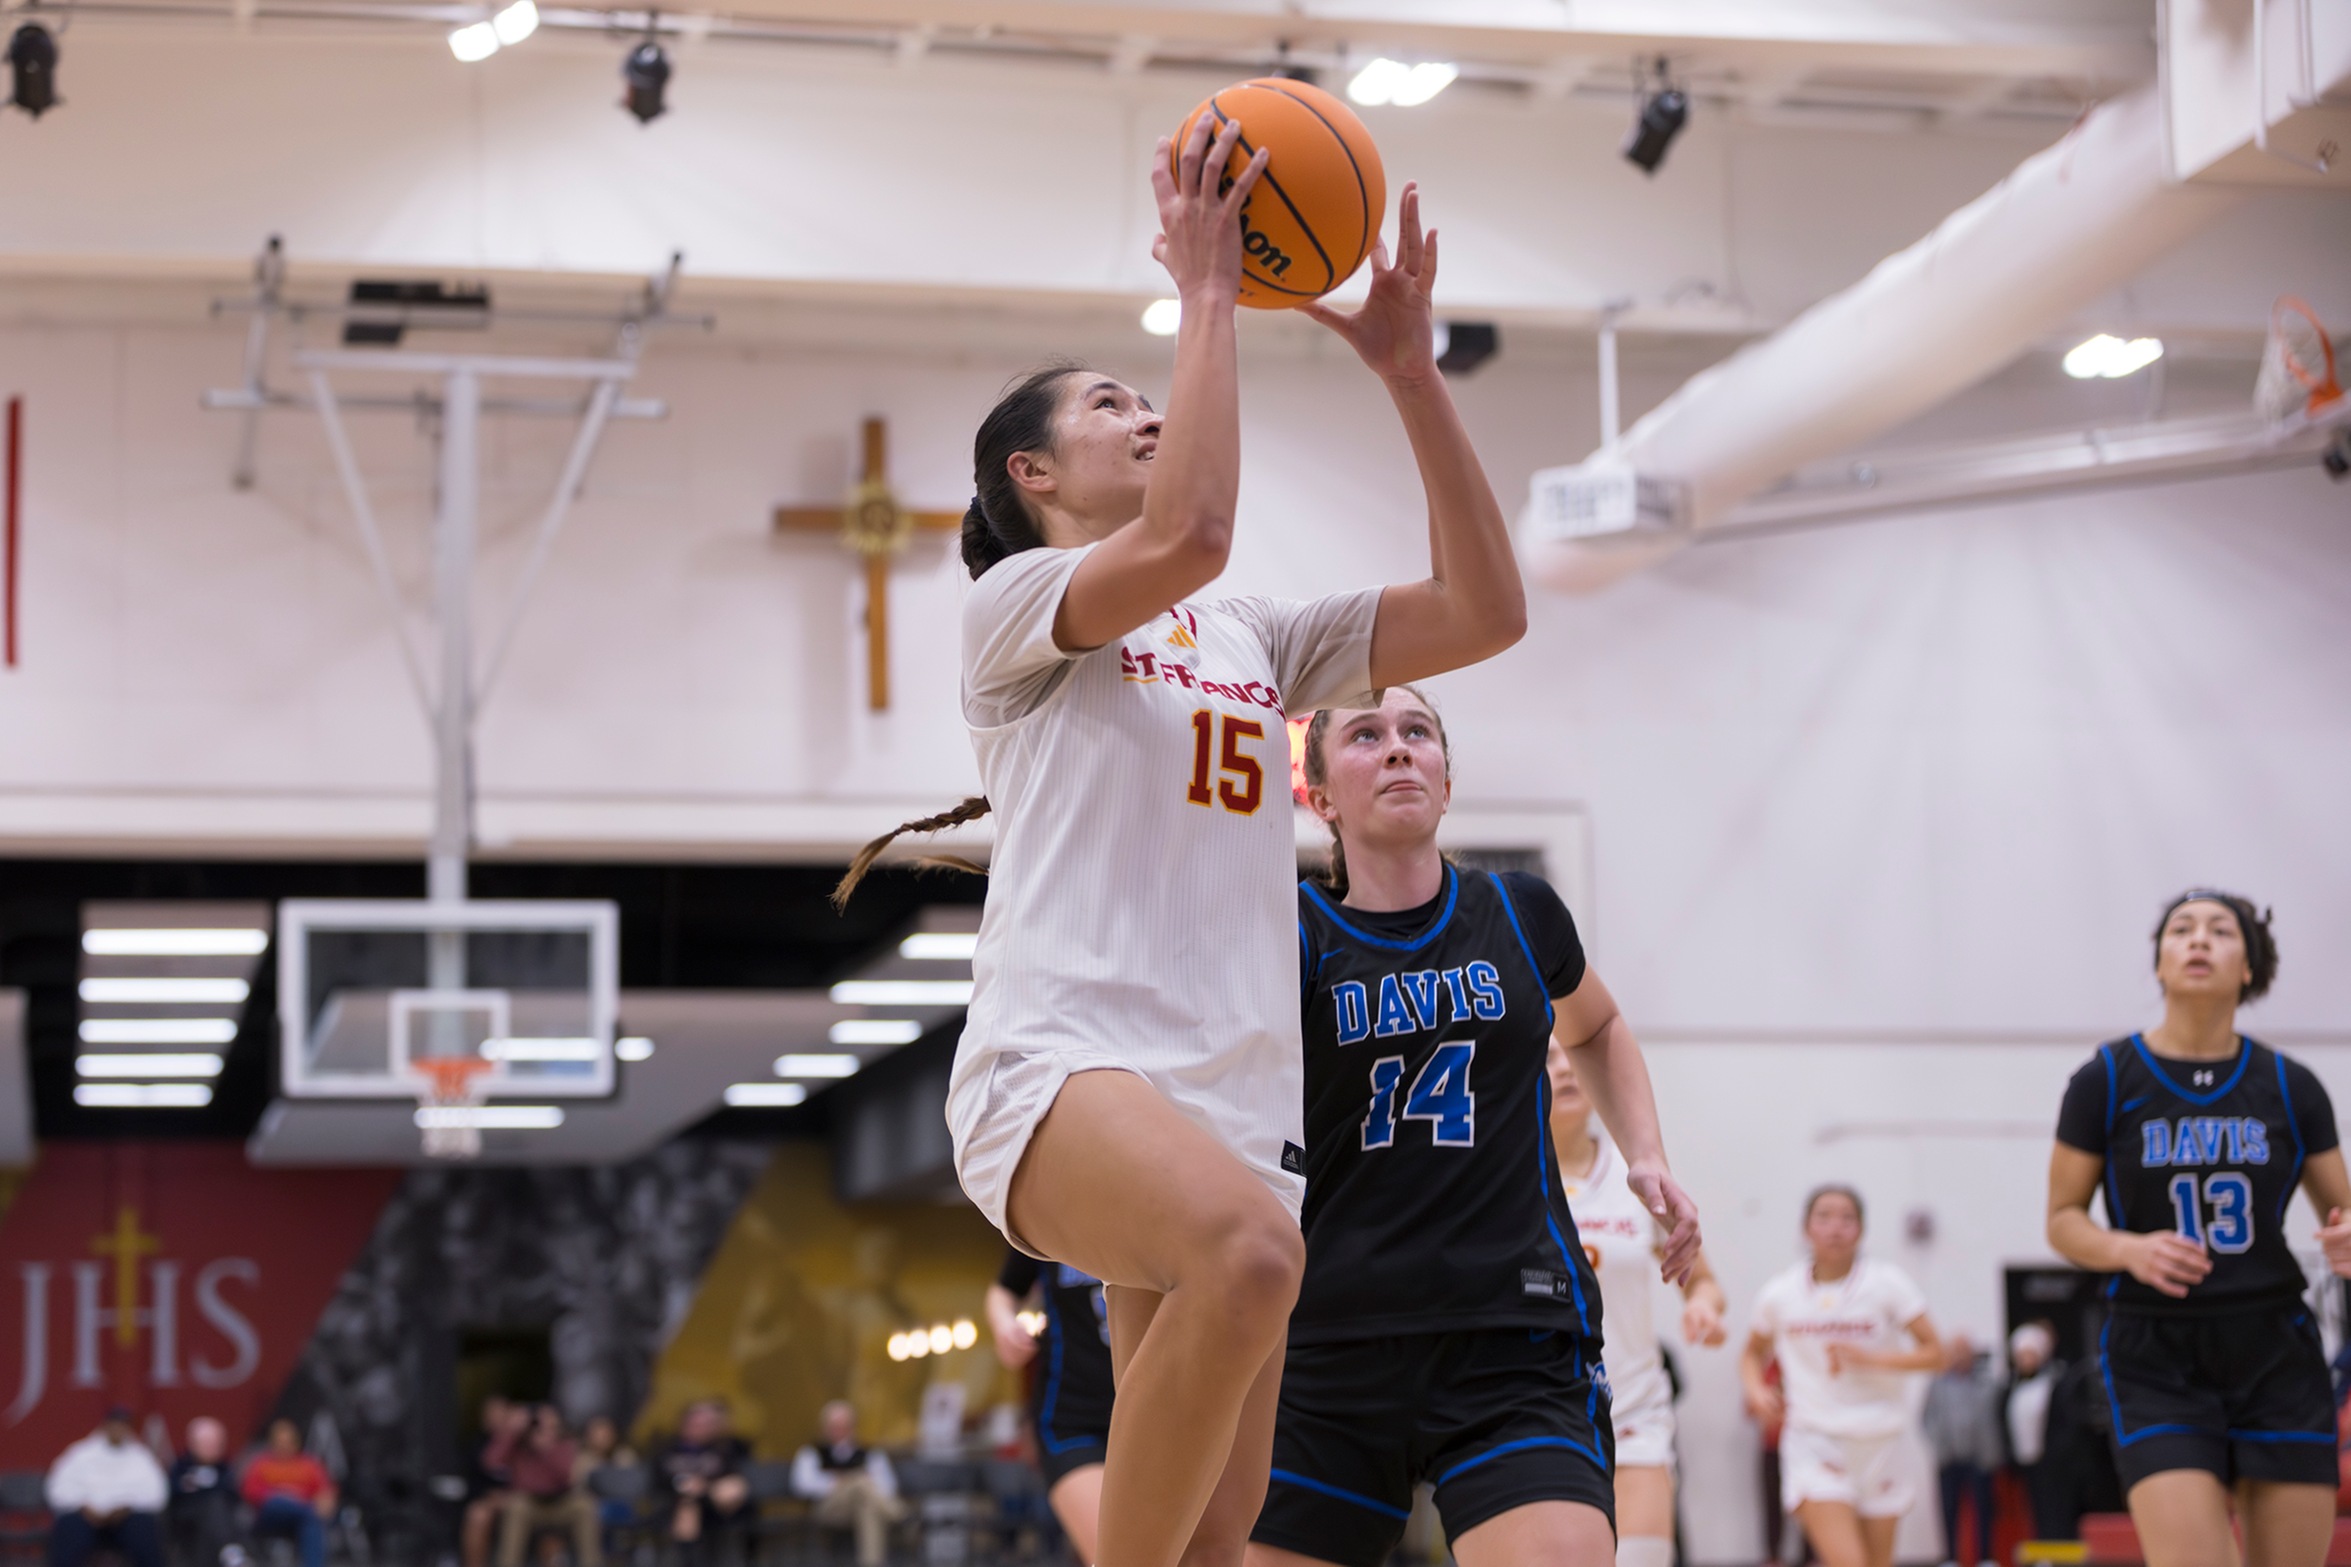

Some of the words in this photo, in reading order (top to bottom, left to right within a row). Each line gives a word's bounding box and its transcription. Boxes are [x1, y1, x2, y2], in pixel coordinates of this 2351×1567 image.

[1121, 646, 1157, 677] ST
[1160, 663, 1286, 721] FRANCS
[1187, 708, 1264, 817] 15
[1331, 960, 1505, 1046] DAVIS
[1360, 1040, 1475, 1151] 14
[2141, 1116, 2270, 1167] DAVIS
[2168, 1171, 2254, 1254] 13
[3, 1256, 261, 1428] JHS
